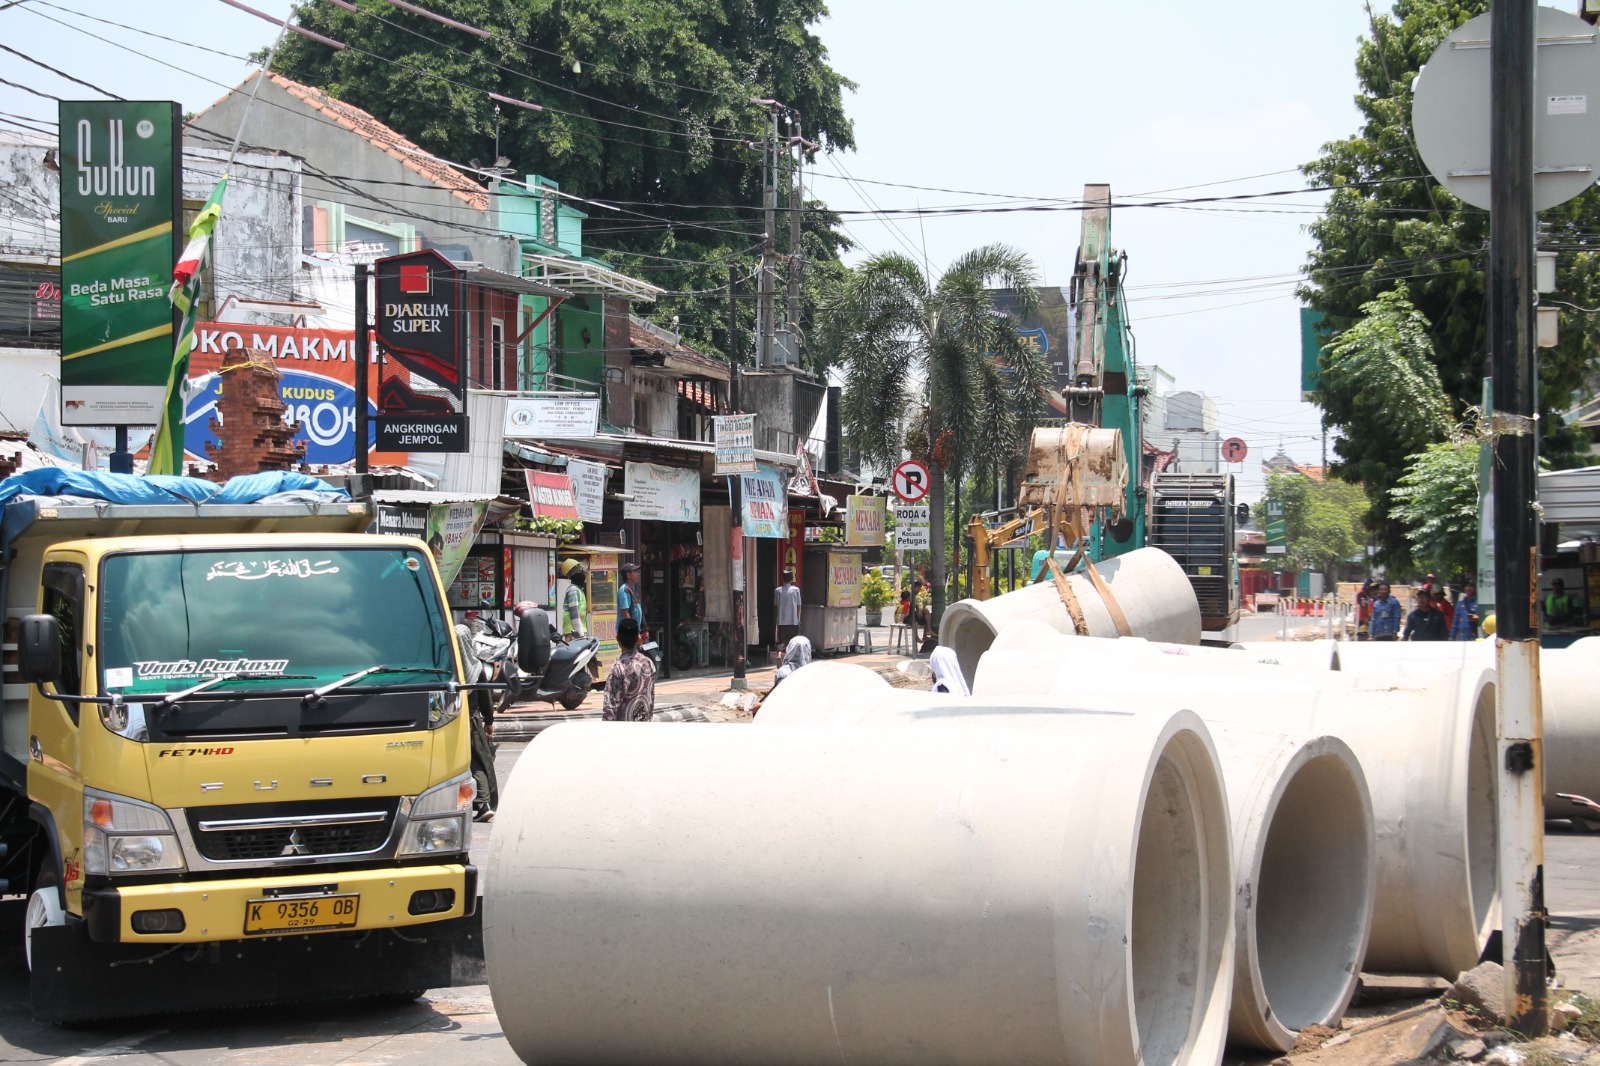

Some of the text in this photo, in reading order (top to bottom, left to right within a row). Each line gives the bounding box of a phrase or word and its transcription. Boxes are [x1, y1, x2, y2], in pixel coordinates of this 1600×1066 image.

[94, 201, 140, 219] Special
[70, 277, 150, 297] Beda Masa
[90, 288, 163, 307] Satu Rasa
[385, 303, 449, 317] DJARUM
[393, 319, 441, 333] SUPER
[282, 387, 336, 401] KUDUS
[384, 424, 458, 434] ANGKRINGAN
[398, 435, 443, 445] JEMPOL
[896, 509, 927, 519] RODA 4
[897, 537, 927, 547] Petugas
[197, 658, 289, 674] Perkasa
[158, 747, 235, 758] FE74HD
[201, 774, 387, 793] FUSO
[252, 905, 263, 921] K
[278, 901, 319, 919] 9356
